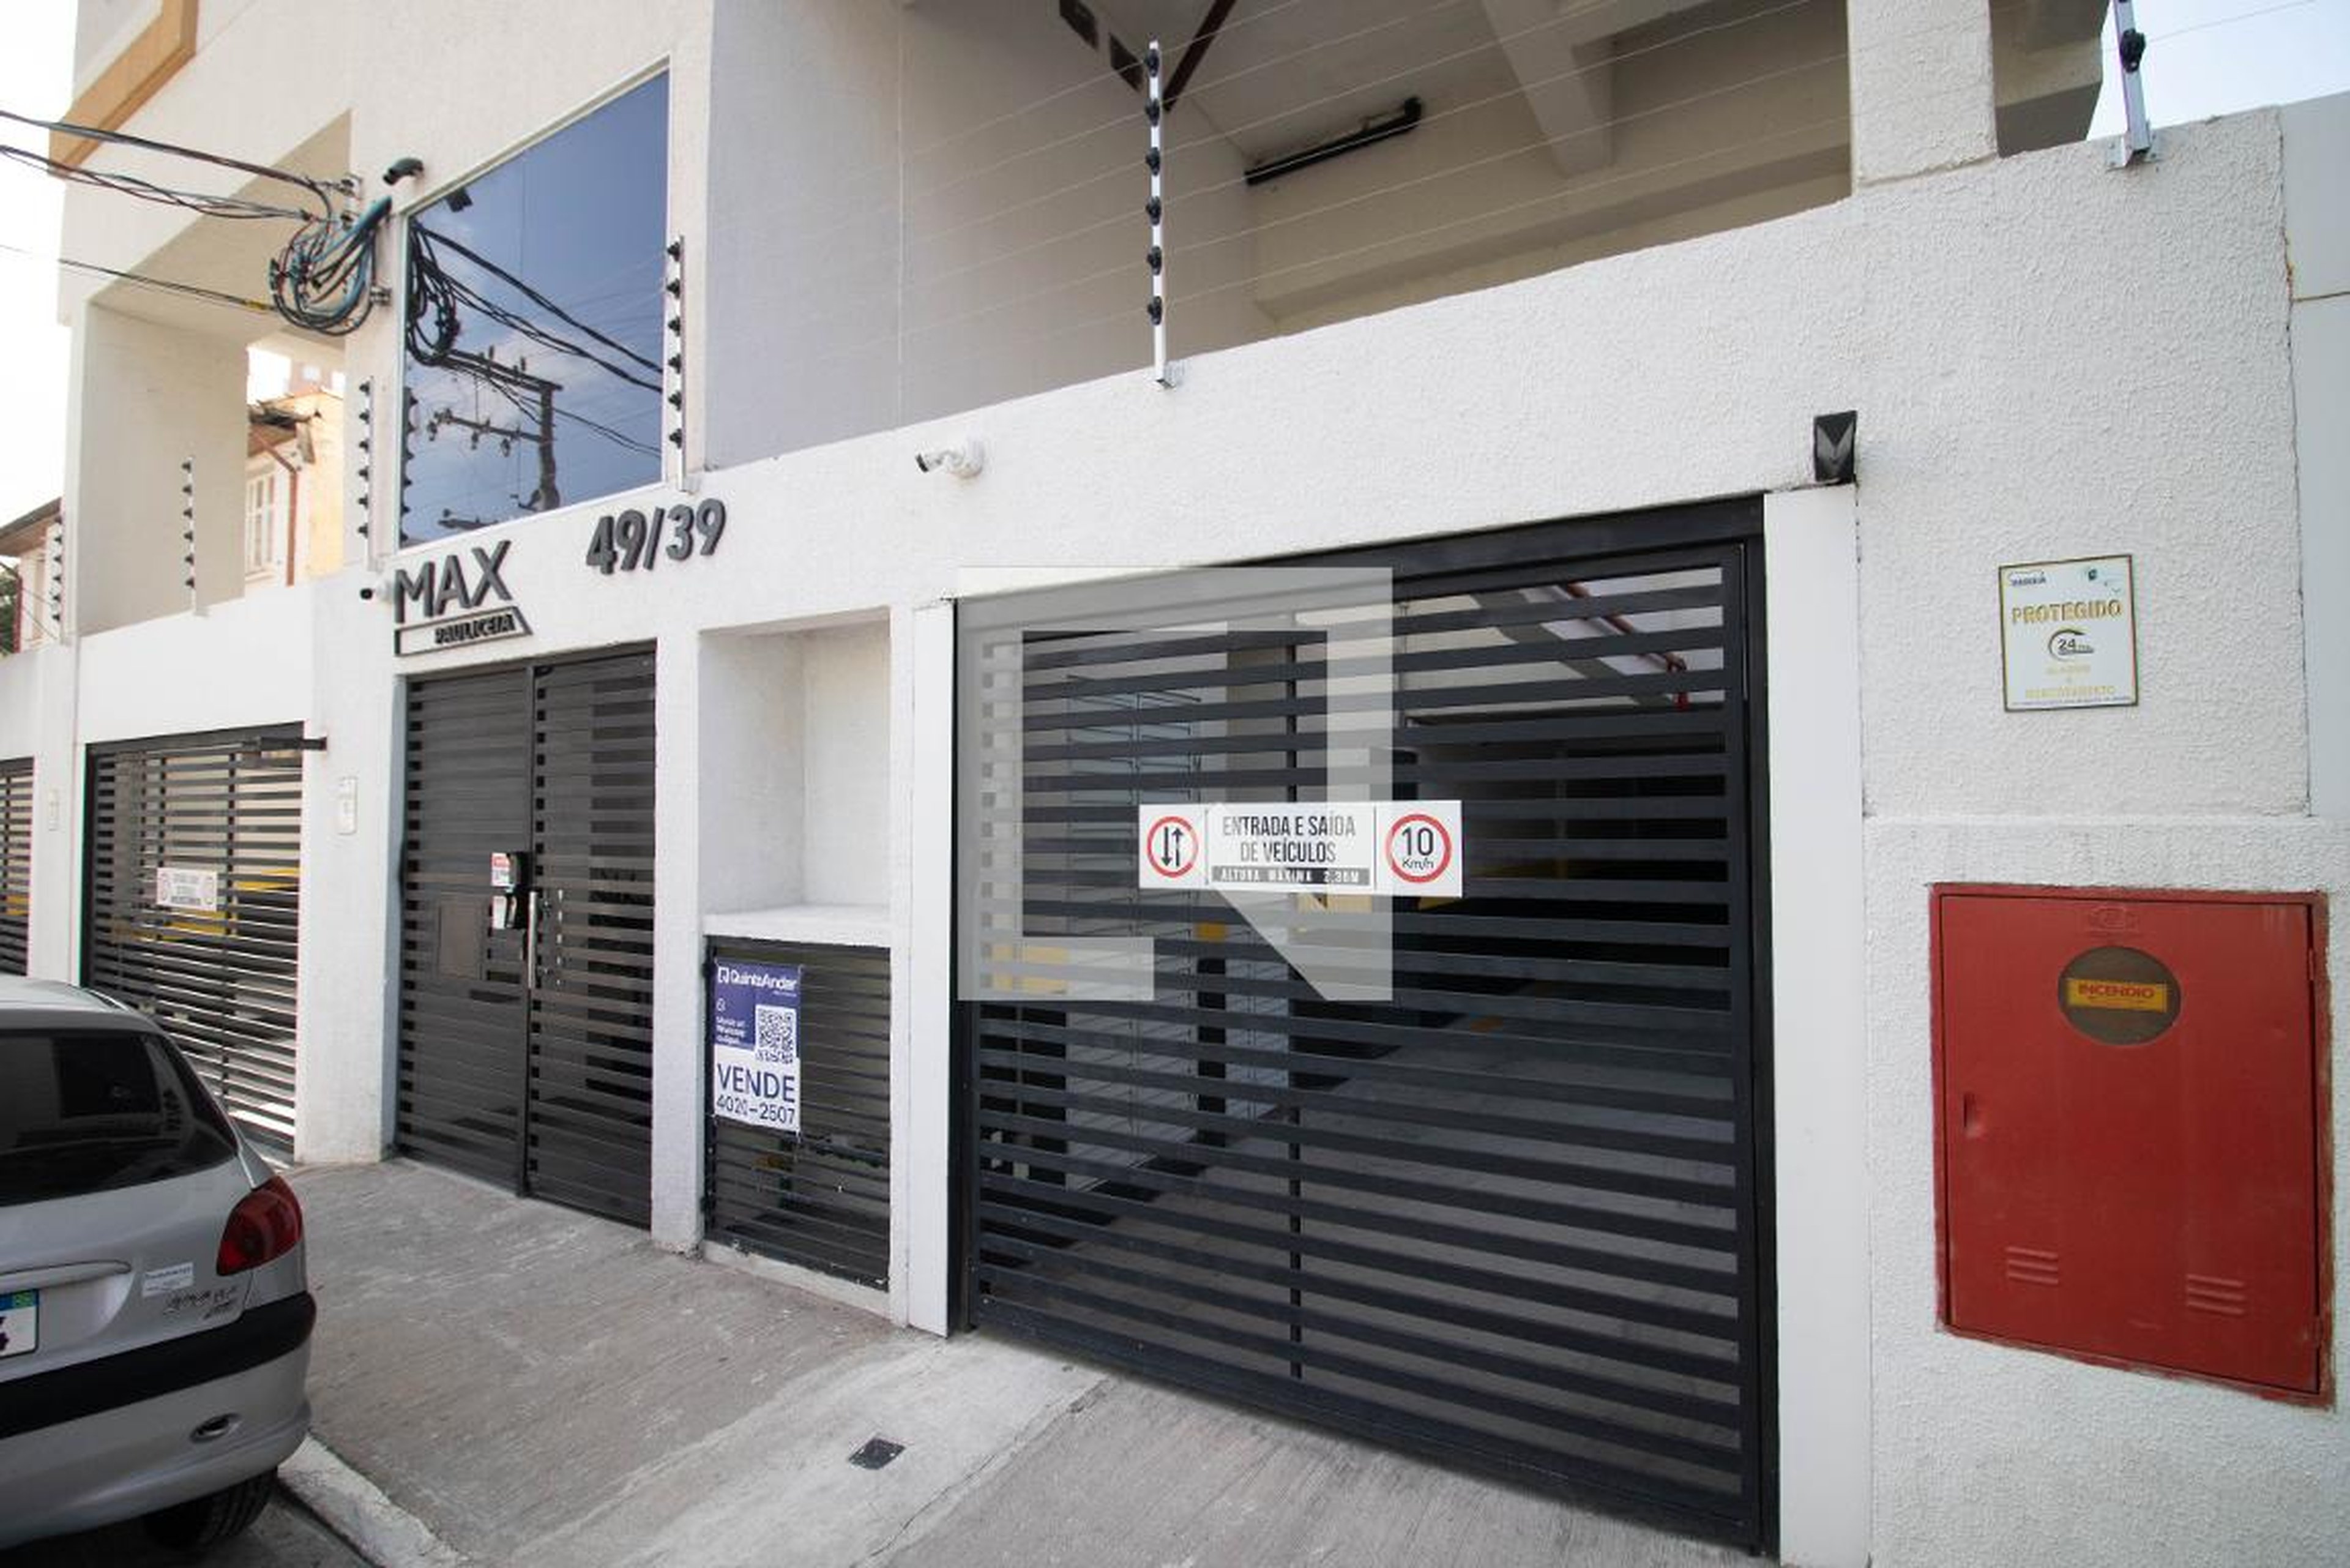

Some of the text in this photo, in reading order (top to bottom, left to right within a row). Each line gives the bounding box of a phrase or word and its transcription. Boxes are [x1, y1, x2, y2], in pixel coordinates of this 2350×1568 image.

[586, 498, 726, 575] 49/39
[395, 540, 513, 622] MAX
[2012, 600, 2122, 624] PROTEGIDO
[1223, 811, 1356, 837] ENTRADA E SAÍDA
[1240, 837, 1337, 863] DE VEÍCULOS
[1402, 827, 1434, 856] 10
[717, 1063, 796, 1103] VENDE
